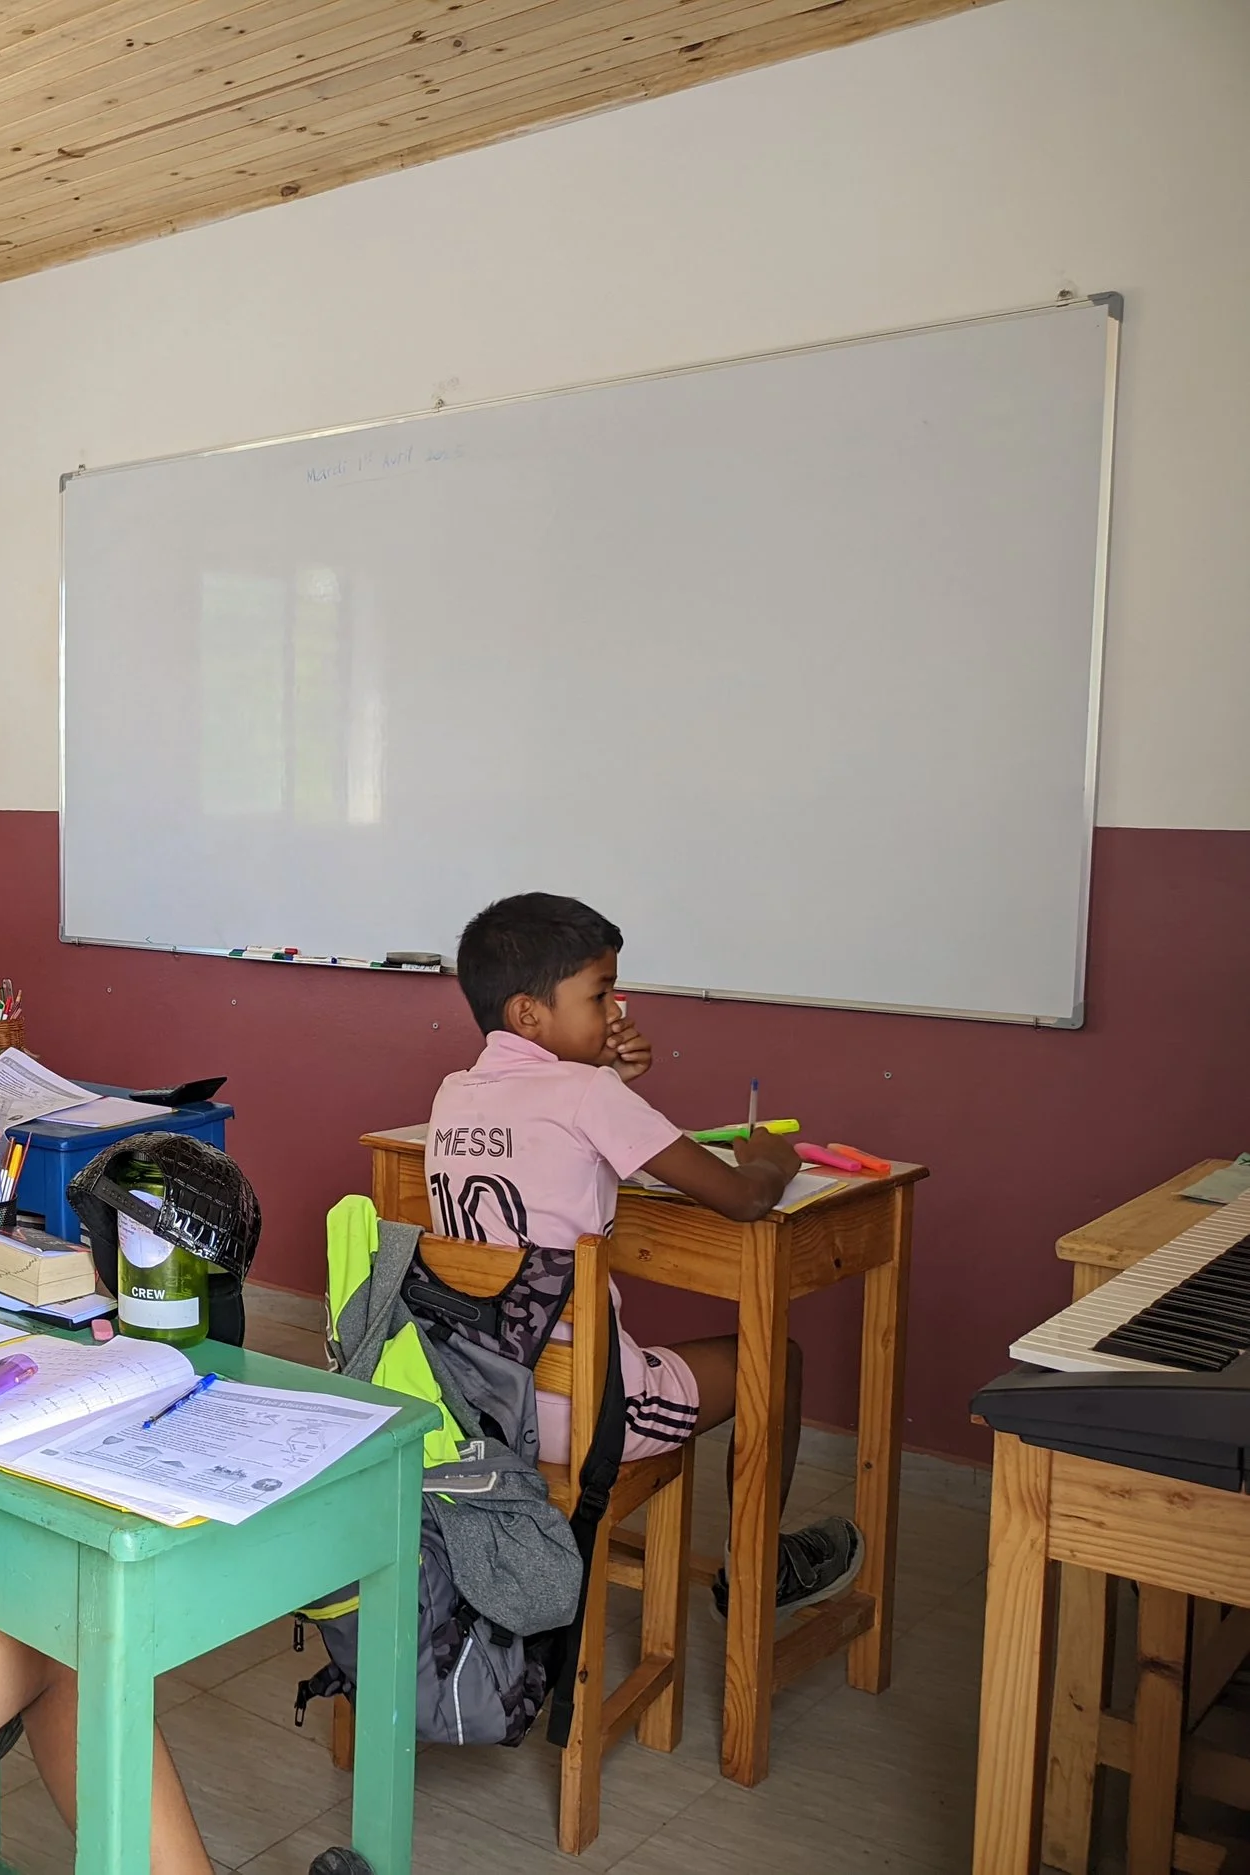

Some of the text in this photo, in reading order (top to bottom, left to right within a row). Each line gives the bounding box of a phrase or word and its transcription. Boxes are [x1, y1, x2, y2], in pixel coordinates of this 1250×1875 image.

[306, 459, 348, 483] Mardi
[382, 445, 414, 468] Avril
[433, 1127, 513, 1158] MESSI
[429, 1171, 529, 1249] 10
[131, 1286, 166, 1300] CREW
